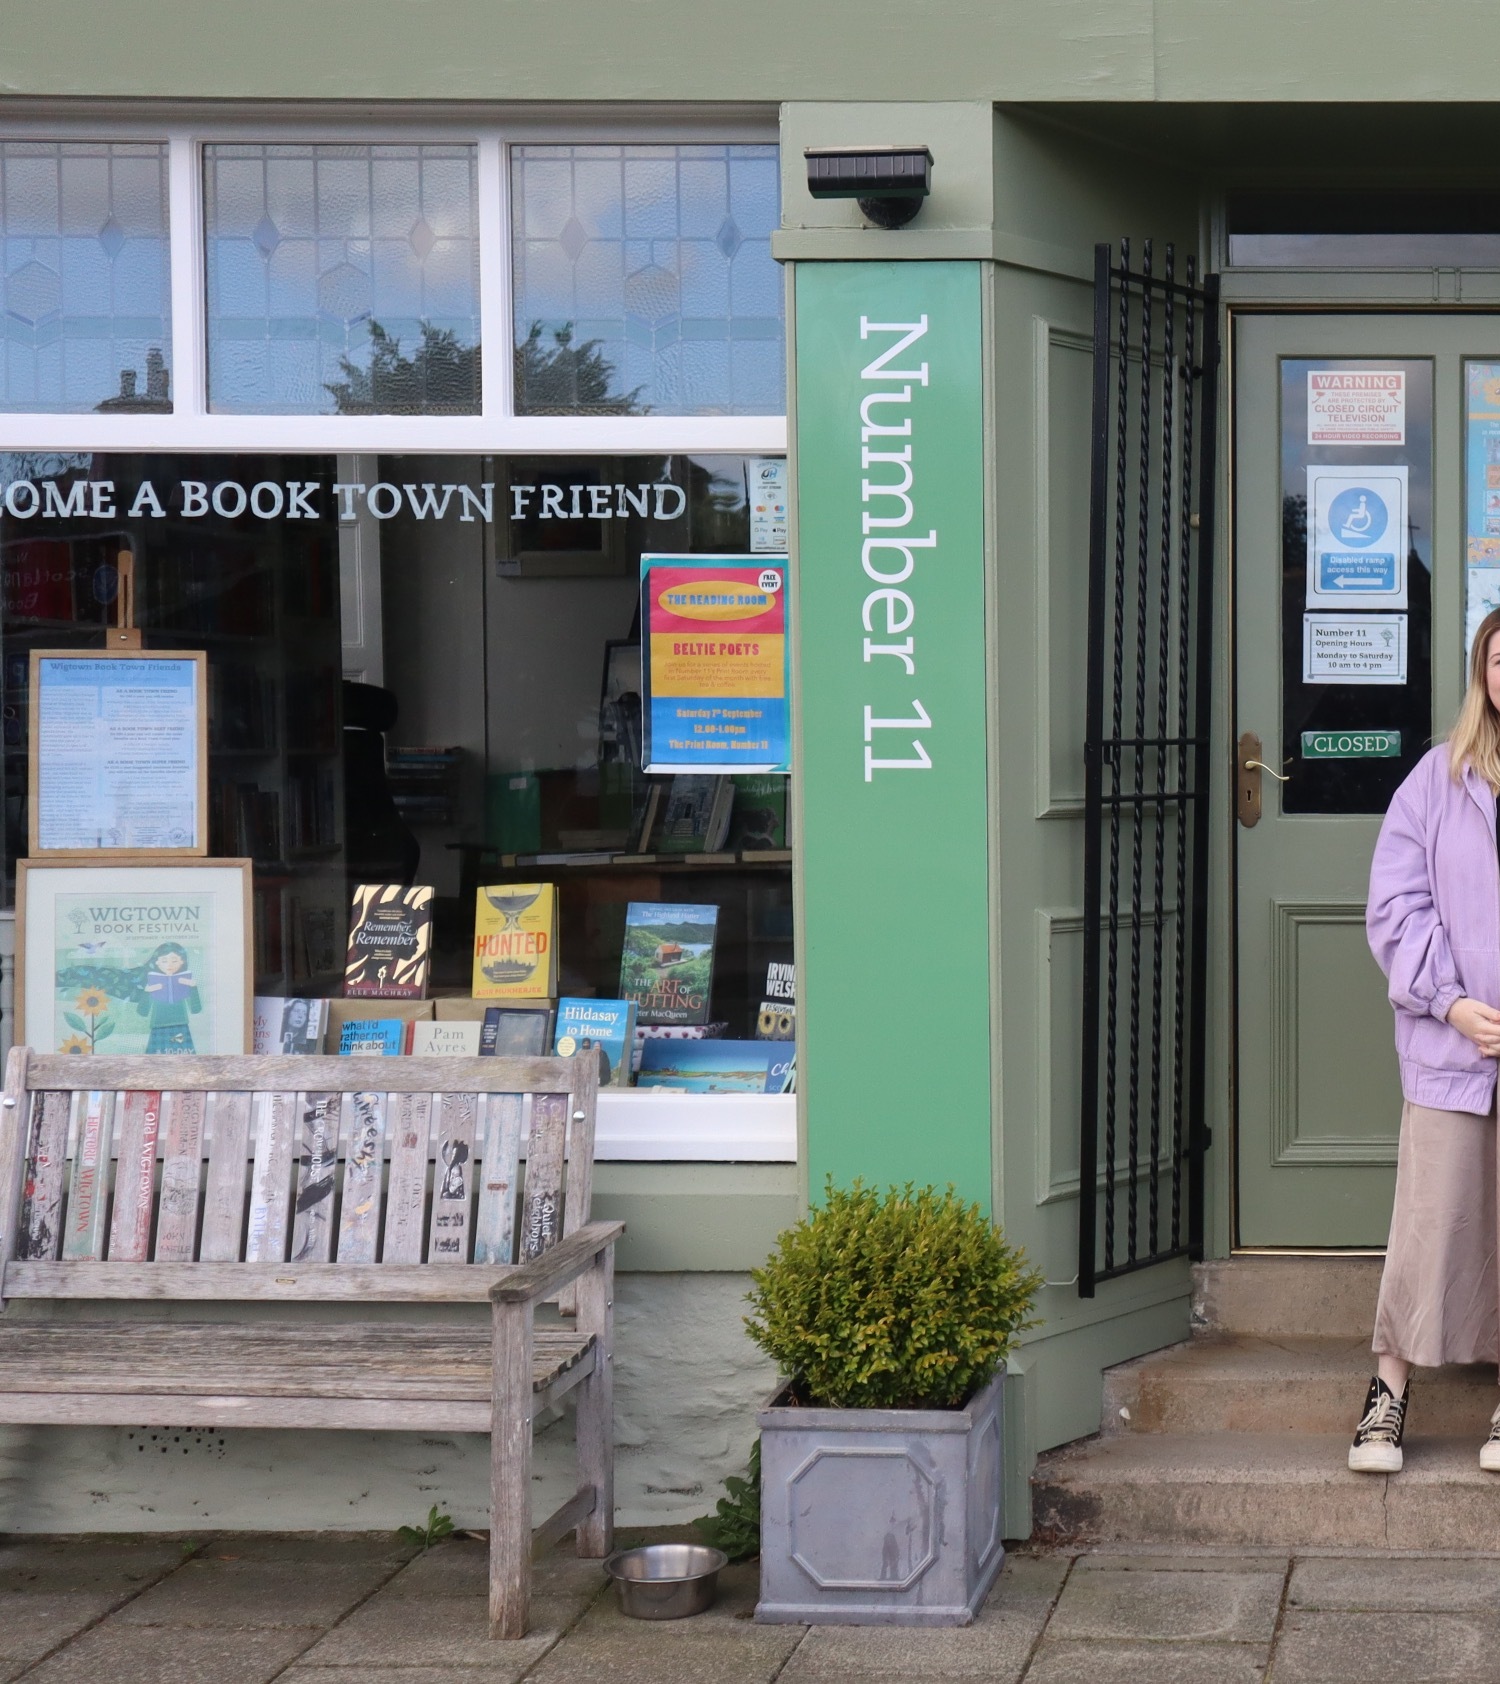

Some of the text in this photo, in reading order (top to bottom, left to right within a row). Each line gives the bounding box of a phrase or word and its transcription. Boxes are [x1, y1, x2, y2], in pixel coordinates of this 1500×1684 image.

[1316, 376, 1397, 388] WARNING
[1314, 404, 1398, 413] CLOSED CIRCUIT
[1328, 414, 1385, 423] TELEVISION
[0, 480, 686, 522] OME A BOOK TOWN FRIEND
[859, 314, 937, 782] Number 11
[1330, 556, 1386, 566] Disabled ramp
[1356, 566, 1370, 574] this
[1373, 568, 1388, 576] way
[668, 594, 768, 606] THE READING ROOM
[1316, 629, 1367, 637] Number 11
[674, 643, 760, 656] BELTIE POETS
[1315, 640, 1373, 648] Opening Hours
[1316, 652, 1393, 660] Monday to Saturday
[50, 663, 181, 672] Wigtown Book Town Friends
[676, 709, 710, 718] Saturday
[722, 709, 762, 718] September
[669, 740, 684, 750] The
[685, 740, 705, 750] Print
[730, 740, 760, 750] Number
[762, 740, 768, 750] 11
[1314, 736, 1389, 752] CLOSED
[89, 906, 200, 922] WIGTOWN
[94, 923, 199, 934] BOOK FESTIVAL
[356, 932, 416, 946] Remember
[476, 932, 548, 957] HUNTED
[767, 962, 795, 981] IRVIN
[650, 980, 682, 994] ART
[564, 1007, 619, 1025] Hildasay
[650, 1010, 687, 1019] MacQueen
[342, 1022, 365, 1031] what
[567, 1024, 612, 1036] to Home
[341, 1030, 388, 1040] rather not
[434, 1028, 464, 1039] Pam
[340, 1040, 396, 1051] think about
[425, 1041, 466, 1054] Ayres
[315, 1100, 328, 1117] THE
[82, 1116, 99, 1166] HISTORIC
[138, 1142, 154, 1209] WIGTOWN
[77, 1168, 95, 1232] WIGTOWN
[541, 1196, 554, 1237] Quiet
